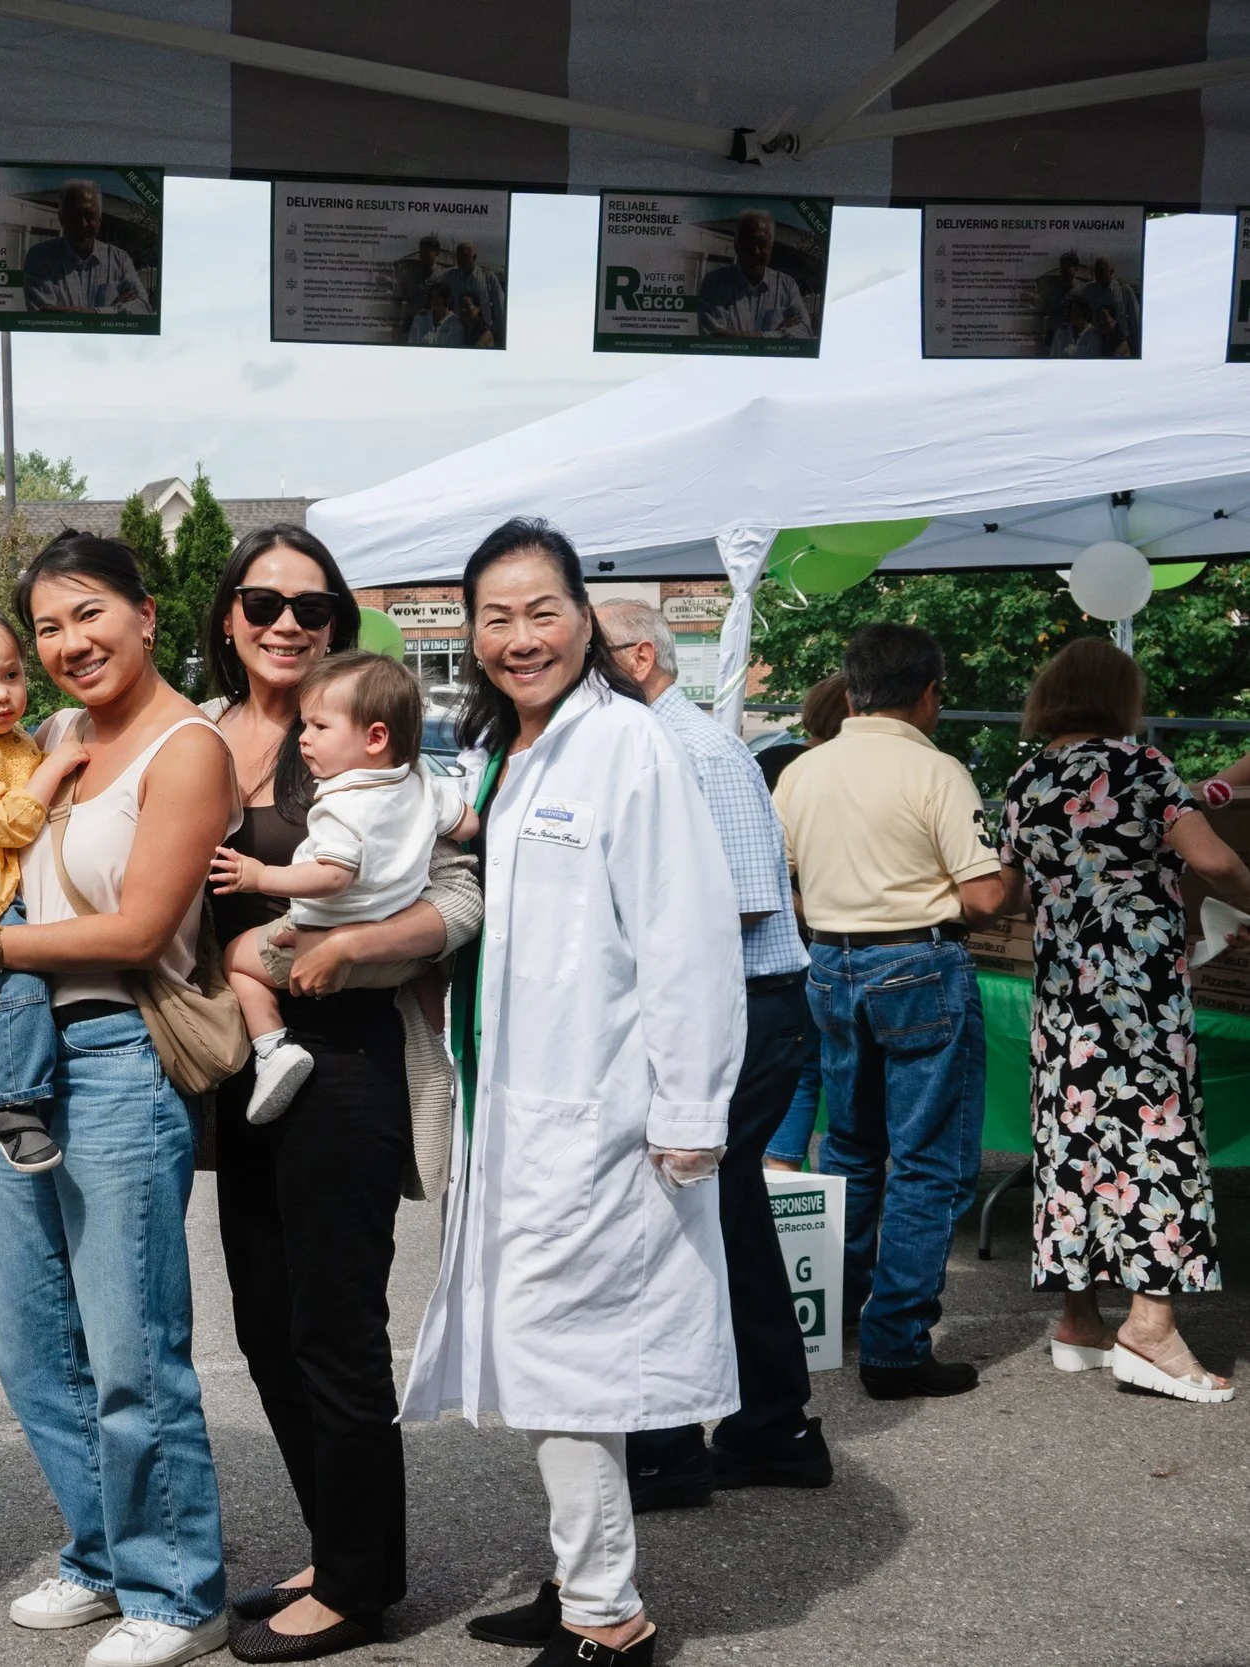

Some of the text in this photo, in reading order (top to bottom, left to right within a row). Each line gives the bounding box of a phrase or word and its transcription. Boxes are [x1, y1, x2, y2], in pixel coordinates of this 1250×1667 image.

[126, 170, 159, 206] RE-ELECT
[286, 197, 488, 215] DELIVERING RESULTS FOR VAUGHAN
[609, 201, 660, 211] RELIABLE.
[608, 213, 682, 224] RESPONSIBLE.
[799, 201, 828, 235] RE-ELECT
[936, 219, 1125, 230] DELIVERING RESULTS FOR VAUGHAN
[608, 225, 675, 236] RESPONSIVE.
[644, 272, 685, 282] VOTE FOR
[643, 284, 672, 294] Mario
[430, 607, 460, 615] WING
[405, 641, 417, 650] W!
[422, 640, 448, 650] WING
[522, 828, 536, 836] Fine
[538, 829, 560, 840] Italian
[770, 1195, 823, 1215] ESPONSIVE
[777, 1220, 825, 1233] GRacco.ca
[795, 1256, 812, 1283] G
